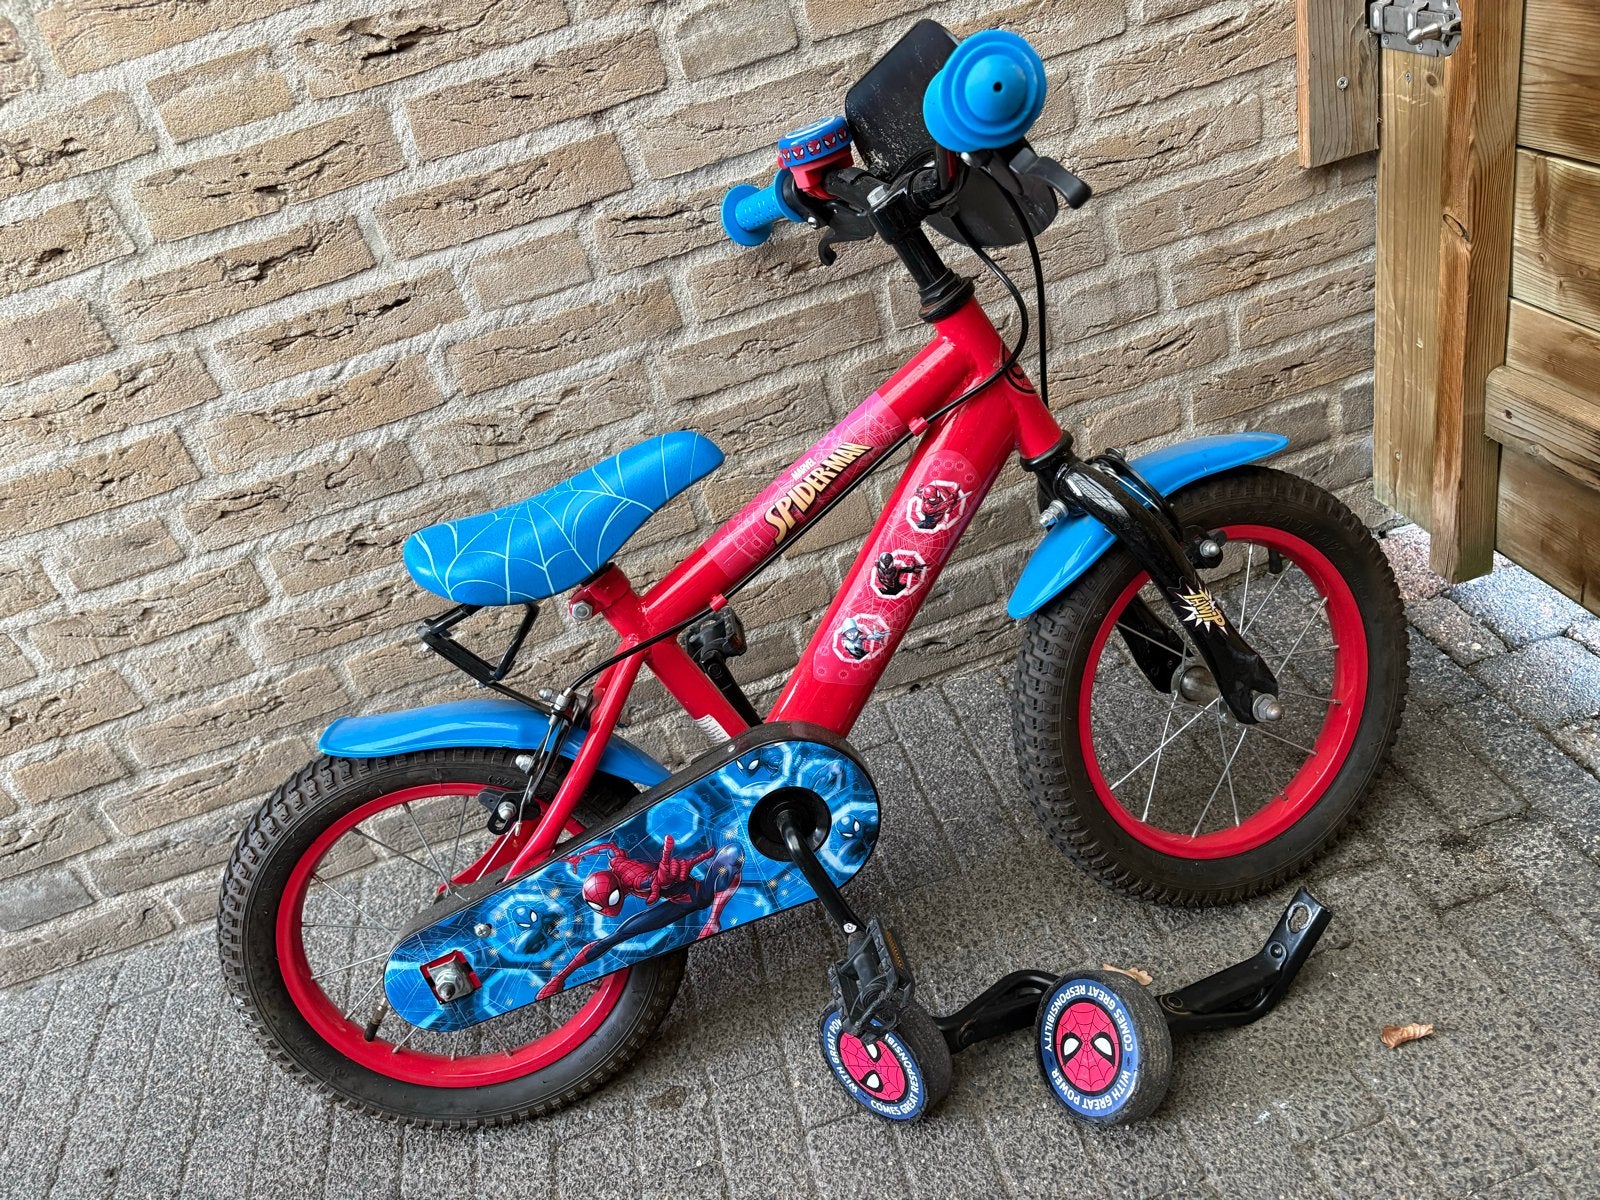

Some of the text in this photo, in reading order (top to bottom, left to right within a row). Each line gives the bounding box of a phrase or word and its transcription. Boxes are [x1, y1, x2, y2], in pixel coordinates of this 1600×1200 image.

[790, 458, 816, 481] MARVEL
[1044, 984, 1133, 1052] COMES GREAT RESPONSIBILITY
[827, 1031, 840, 1064] GREAT
[836, 1066, 858, 1094] WITH
[870, 1033, 920, 1116] COMES GREAT RESPONSIBI
[1051, 1067, 1131, 1110] WITH GREAT POWER
